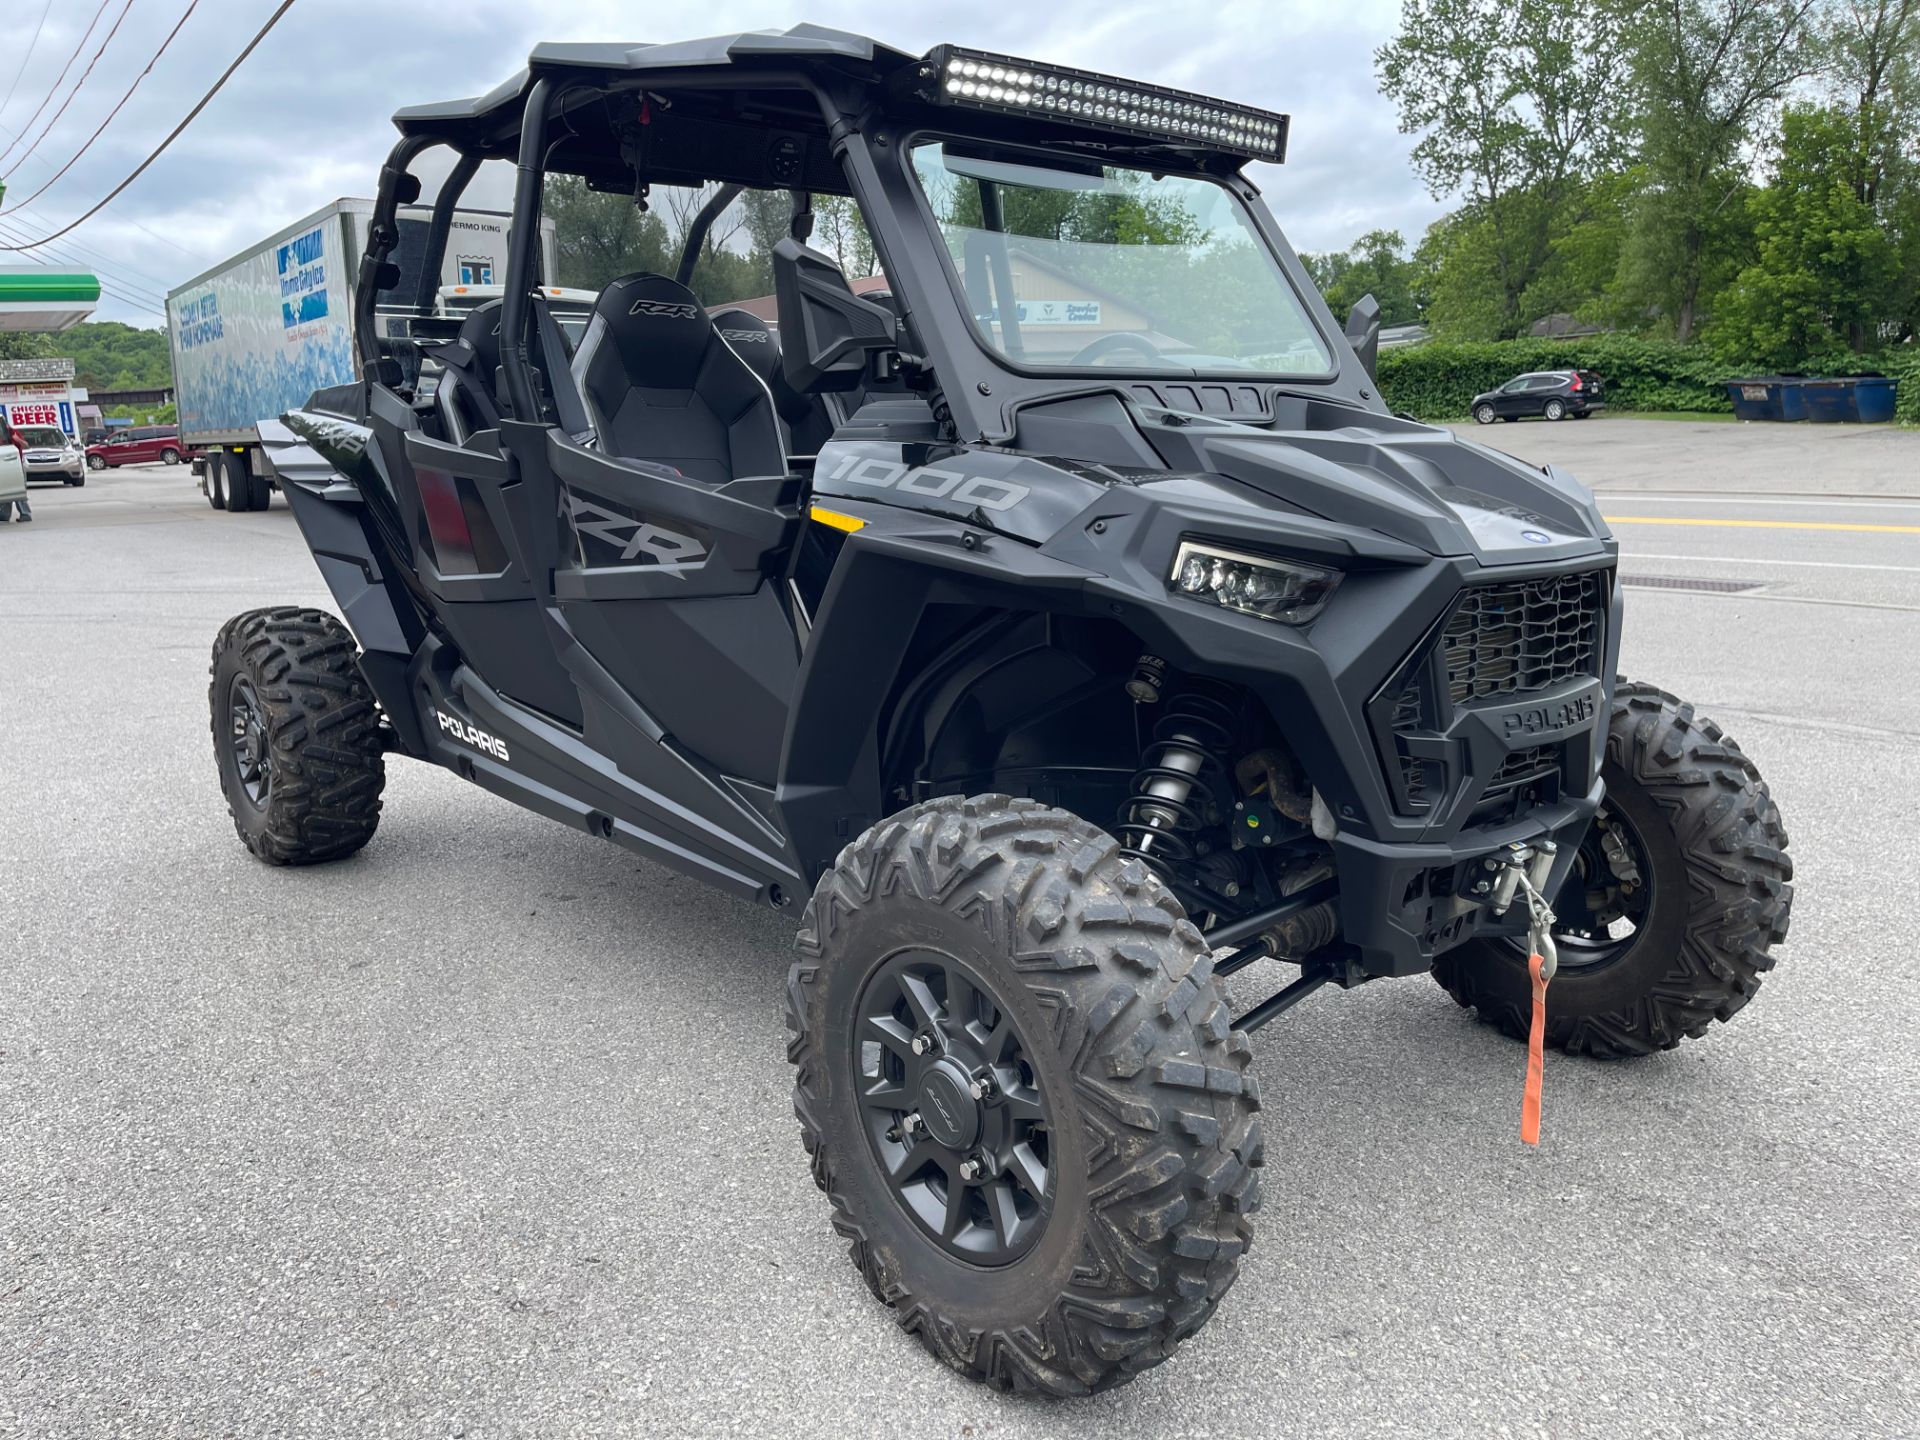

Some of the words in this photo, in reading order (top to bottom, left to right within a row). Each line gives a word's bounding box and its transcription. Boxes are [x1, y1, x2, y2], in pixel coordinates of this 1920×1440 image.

[481, 225, 501, 233] KING
[280, 275, 299, 298] Home
[299, 267, 313, 292] City
[313, 264, 325, 285] Ice
[629, 299, 697, 319] RZR
[721, 329, 768, 343] RZR
[11, 404, 56, 413] CHICORA
[12, 411, 57, 426] BEER
[829, 454, 1031, 512] 1000
[557, 484, 707, 580] RZR
[1501, 694, 1594, 740] POLARIS
[437, 710, 510, 762] POLARIS
